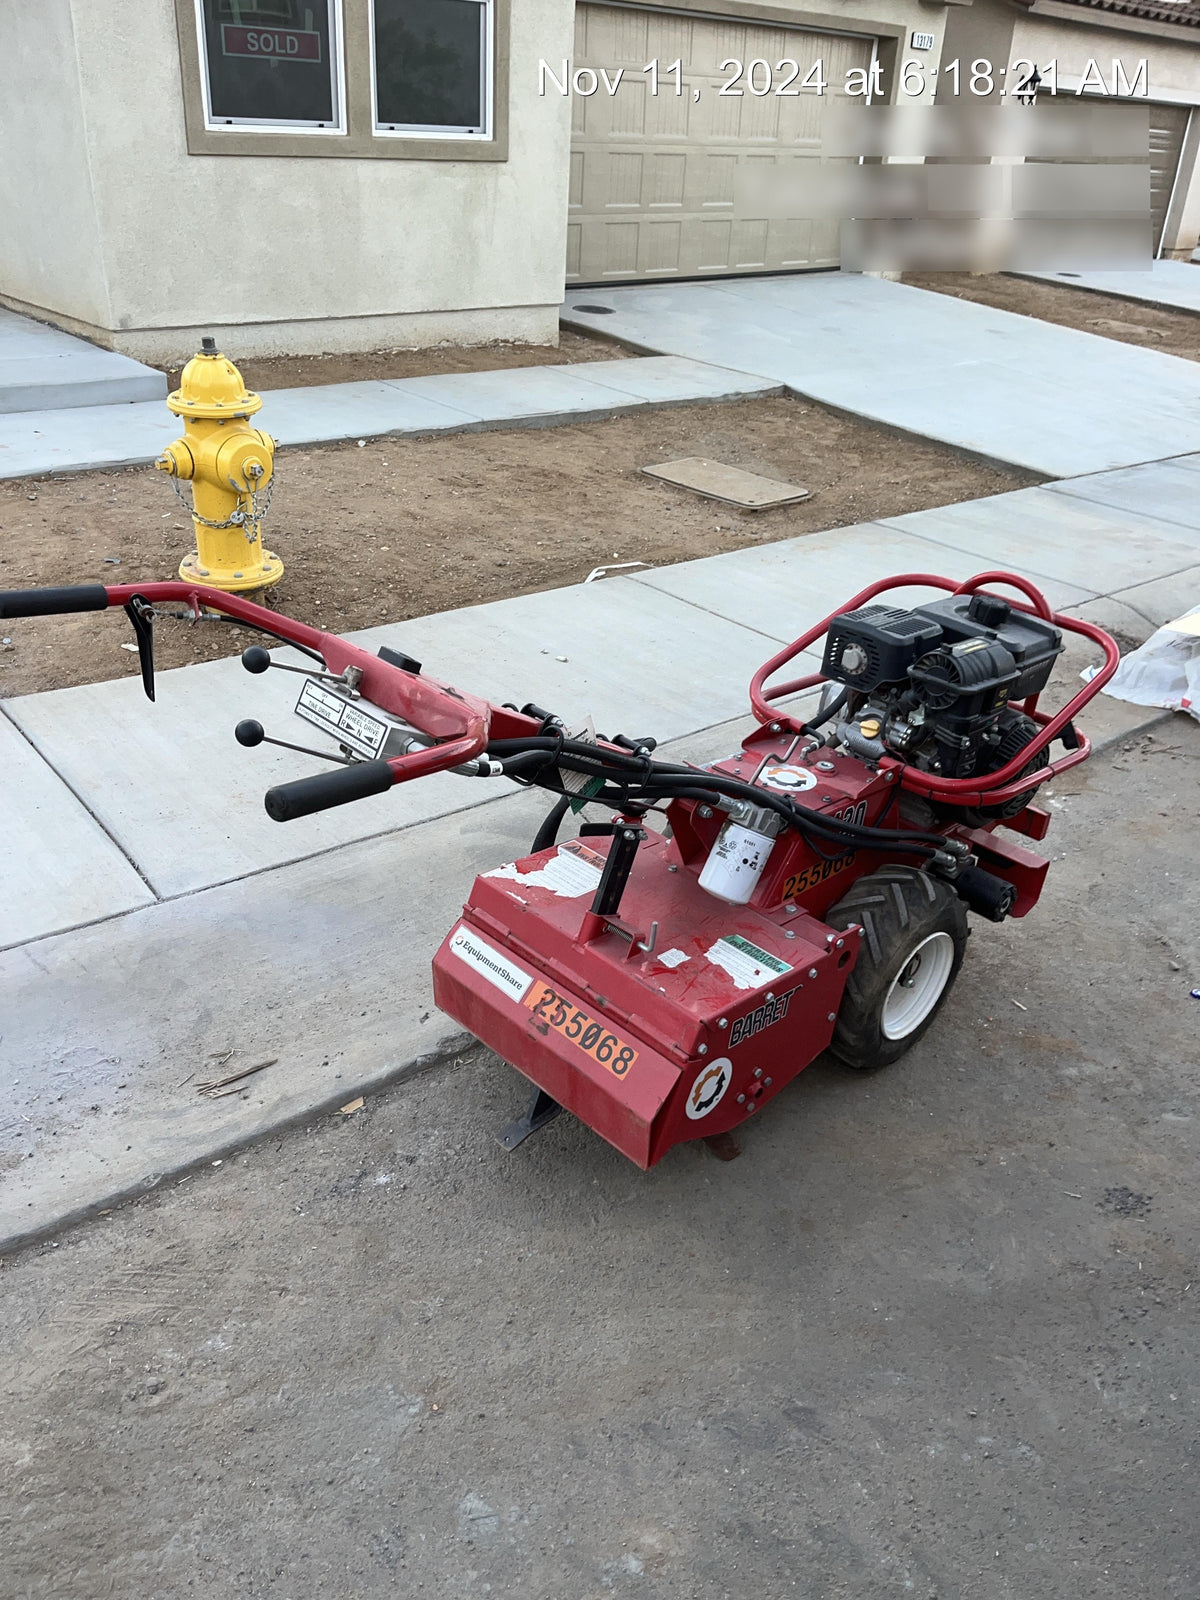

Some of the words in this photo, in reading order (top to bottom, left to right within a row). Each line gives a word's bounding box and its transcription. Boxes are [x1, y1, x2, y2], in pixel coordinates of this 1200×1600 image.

[247, 32, 299, 54] SOLD
[307, 701, 319, 710] TINE
[317, 707, 332, 718] DRIVE
[348, 708, 368, 722] VARIABLE
[367, 720, 381, 730] SPEED
[340, 719, 347, 727] R
[356, 729, 363, 737] N
[372, 738, 379, 746] F
[345, 713, 365, 727] WHEEL
[363, 724, 381, 737] DRIVE
[462, 940, 523, 991] EquipmentShare
[533, 988, 635, 1076] 255068
